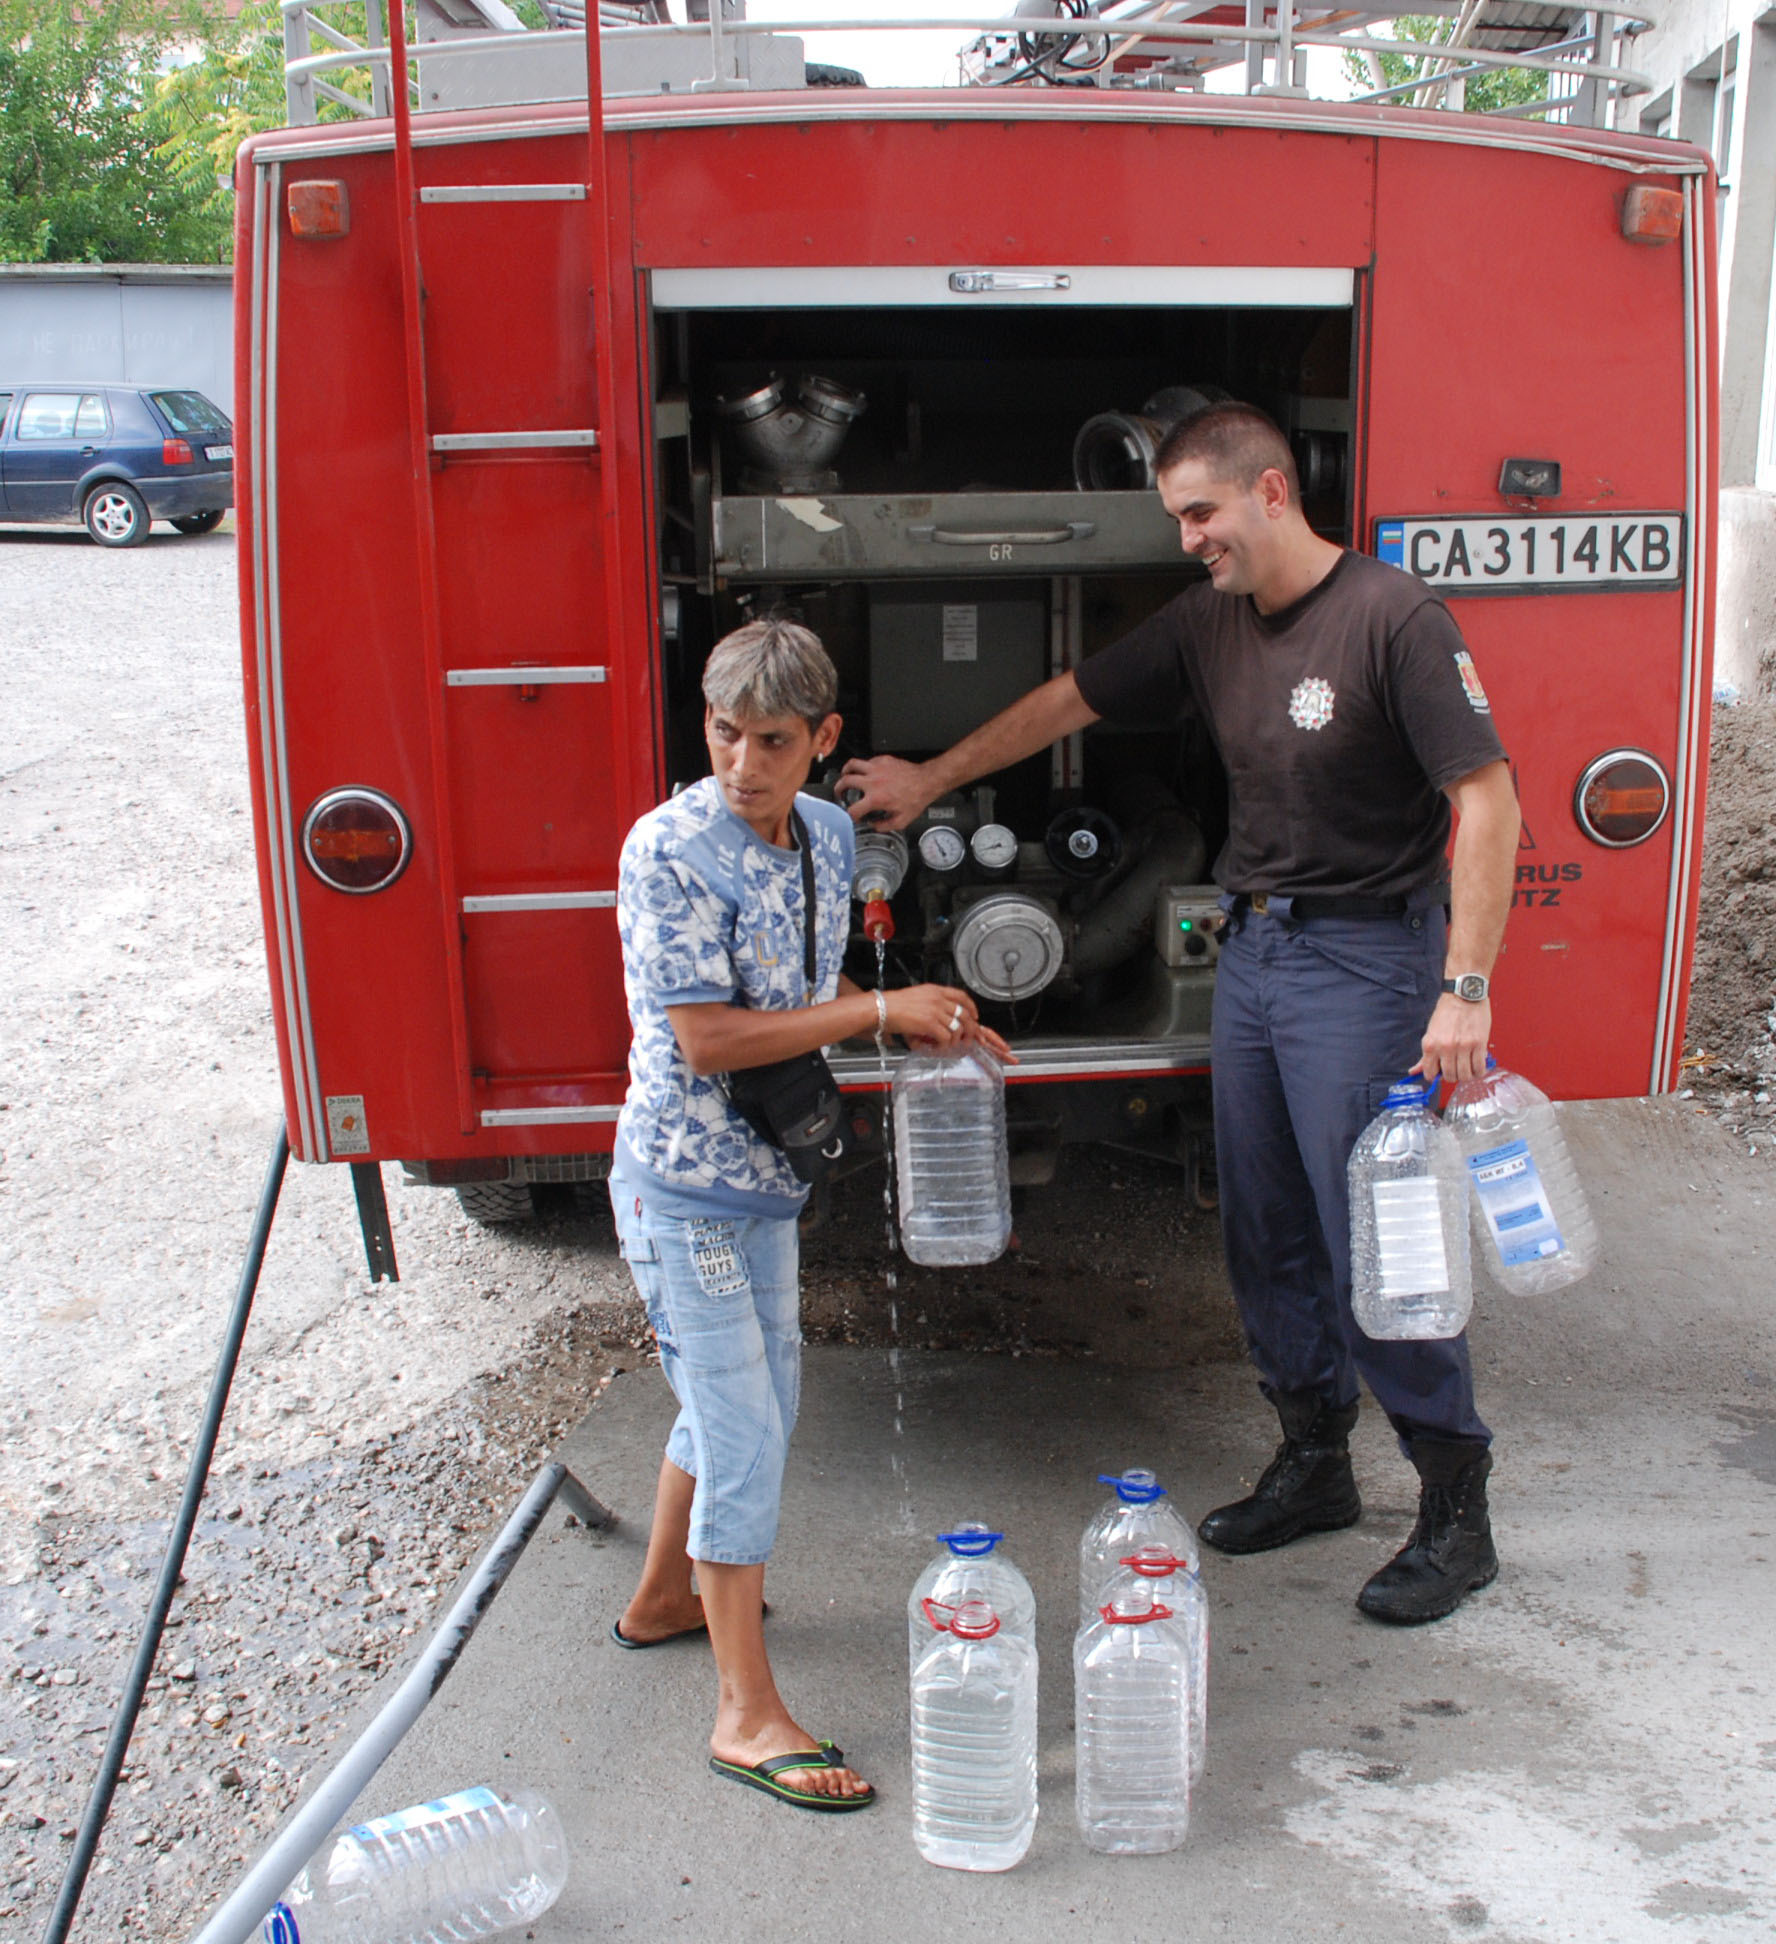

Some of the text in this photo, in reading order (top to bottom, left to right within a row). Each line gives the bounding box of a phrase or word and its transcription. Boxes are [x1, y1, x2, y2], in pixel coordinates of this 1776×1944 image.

[990, 543, 1012, 561] GR
[1515, 862, 1583, 884] RUS
[698, 1258, 733, 1277] GUYS
